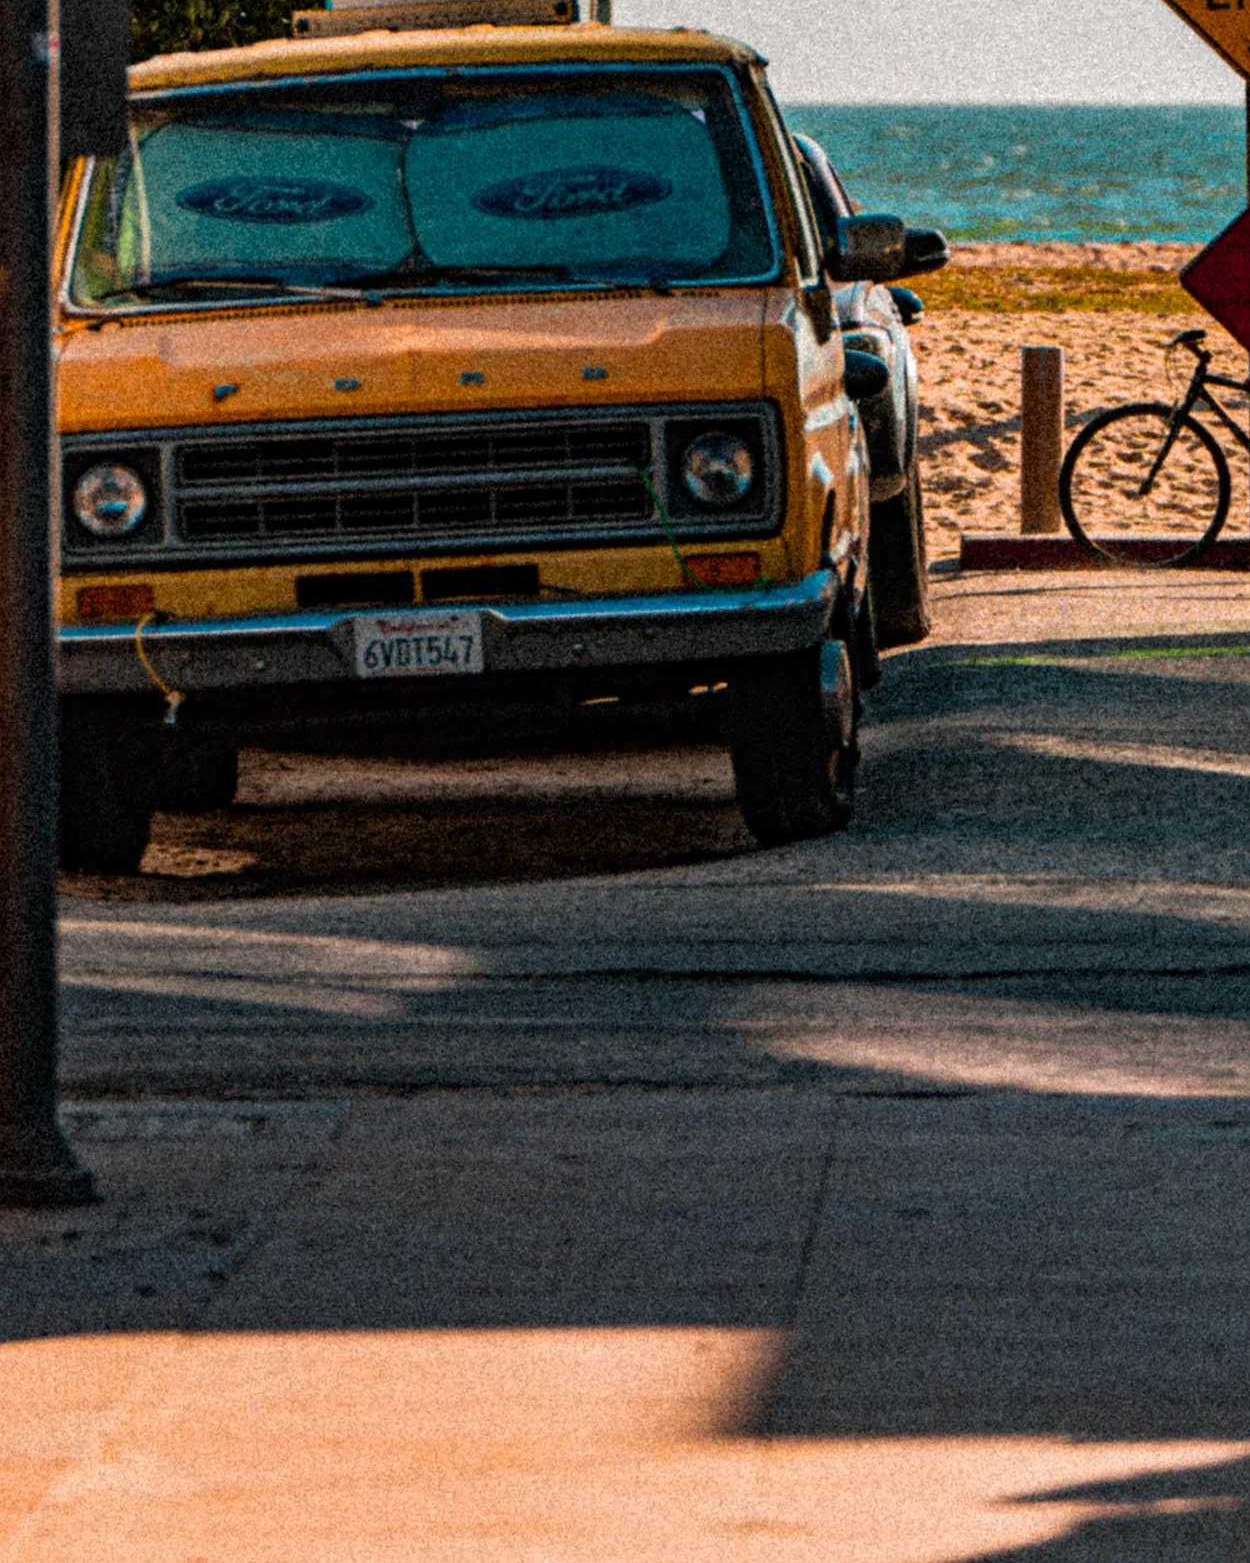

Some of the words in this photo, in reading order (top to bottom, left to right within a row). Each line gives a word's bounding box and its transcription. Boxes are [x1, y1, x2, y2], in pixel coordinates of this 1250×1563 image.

[213, 184, 332, 216] Ford
[513, 174, 630, 213] Ford
[363, 635, 474, 669] 6VDT547
